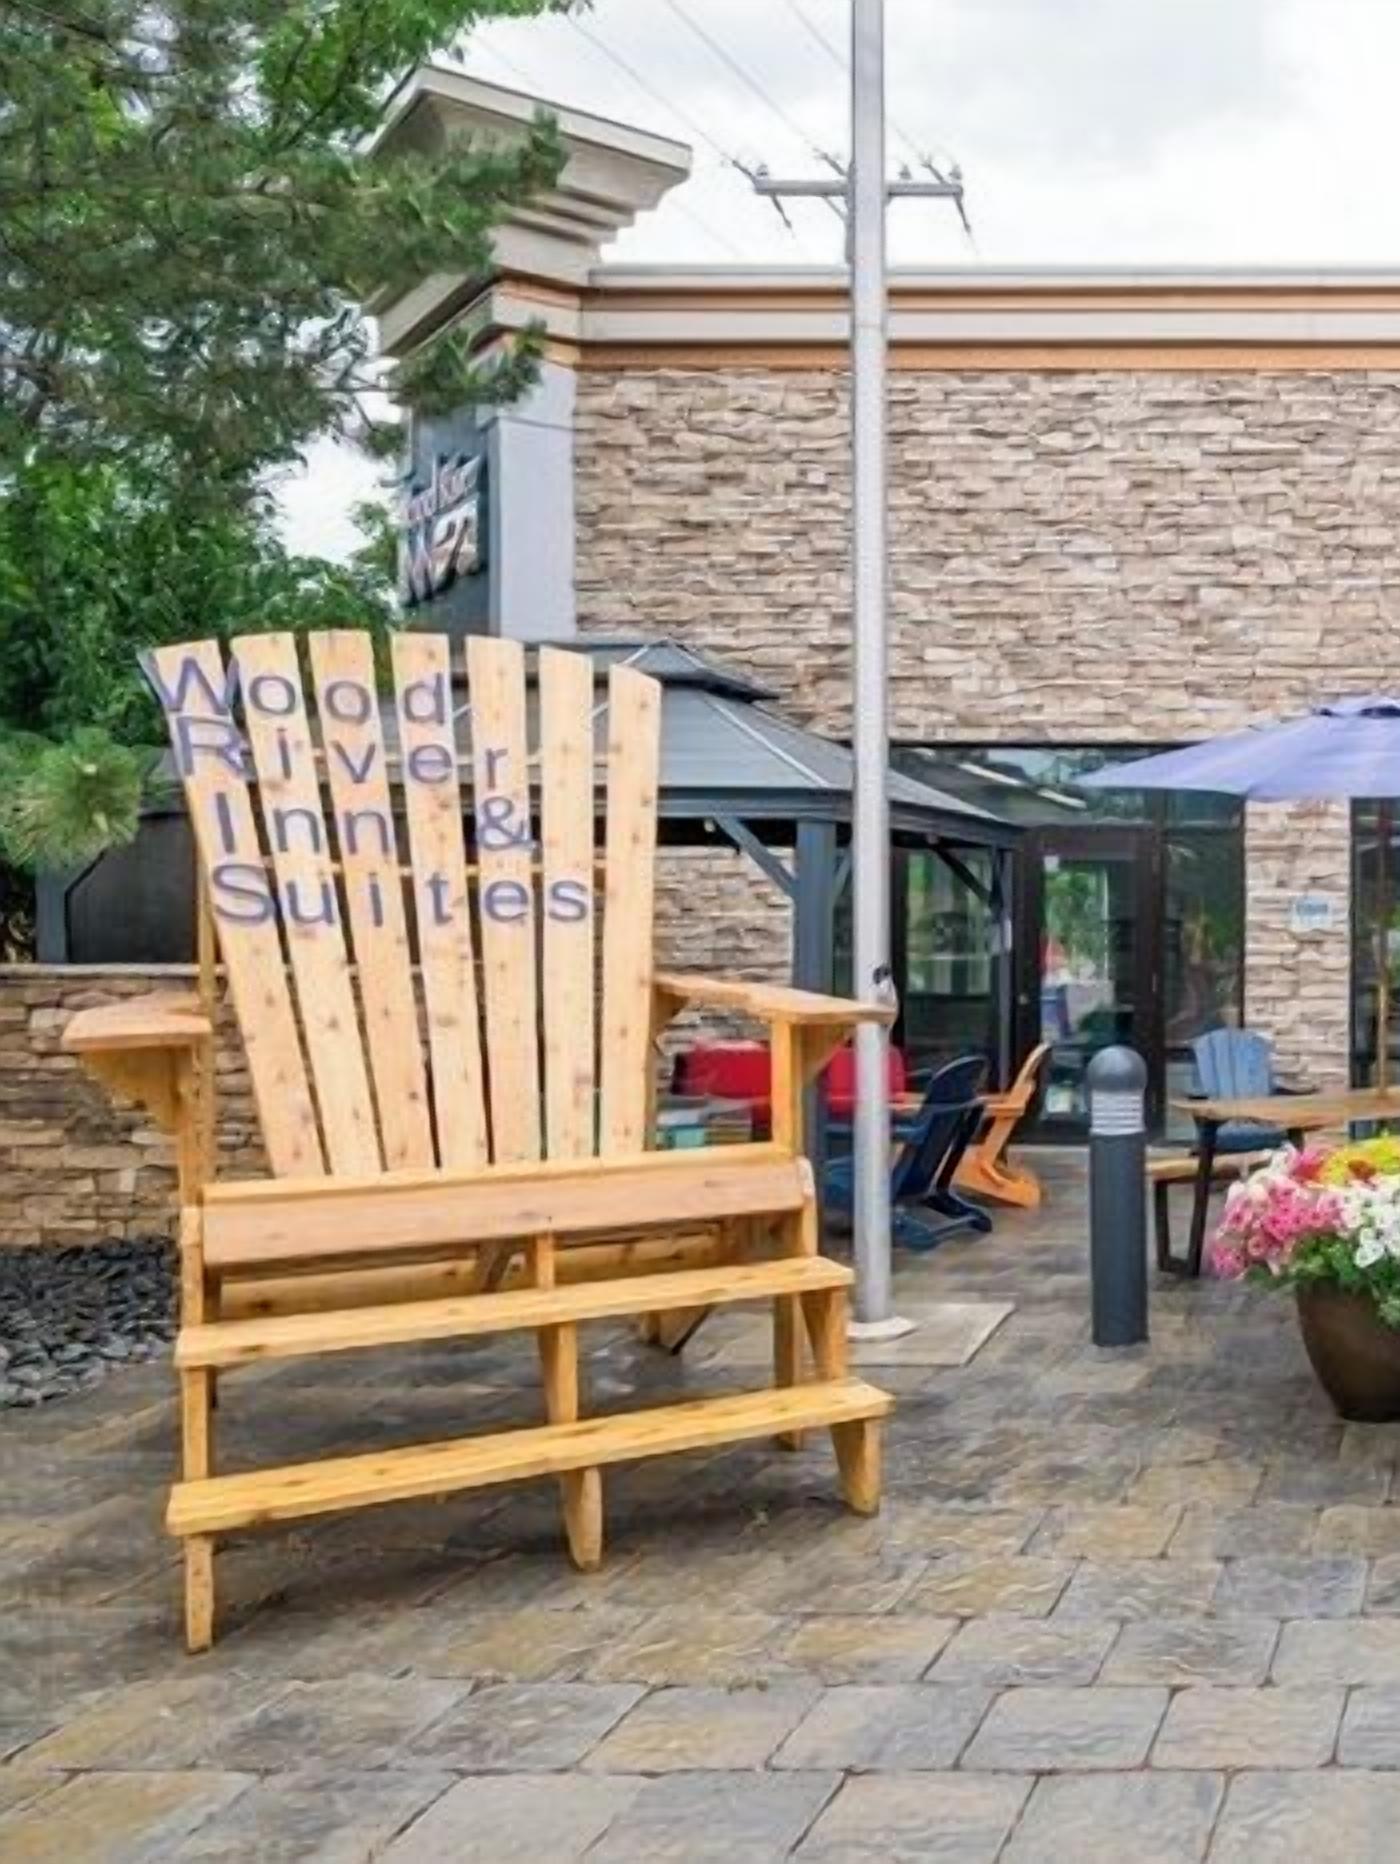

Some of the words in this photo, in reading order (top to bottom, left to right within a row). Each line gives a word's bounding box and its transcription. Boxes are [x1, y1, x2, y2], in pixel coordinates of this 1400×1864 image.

[137, 646, 447, 726] Wood
[174, 714, 510, 789] River
[216, 791, 391, 856] Inn
[477, 796, 537, 851] &
[212, 862, 590, 928] Suites
